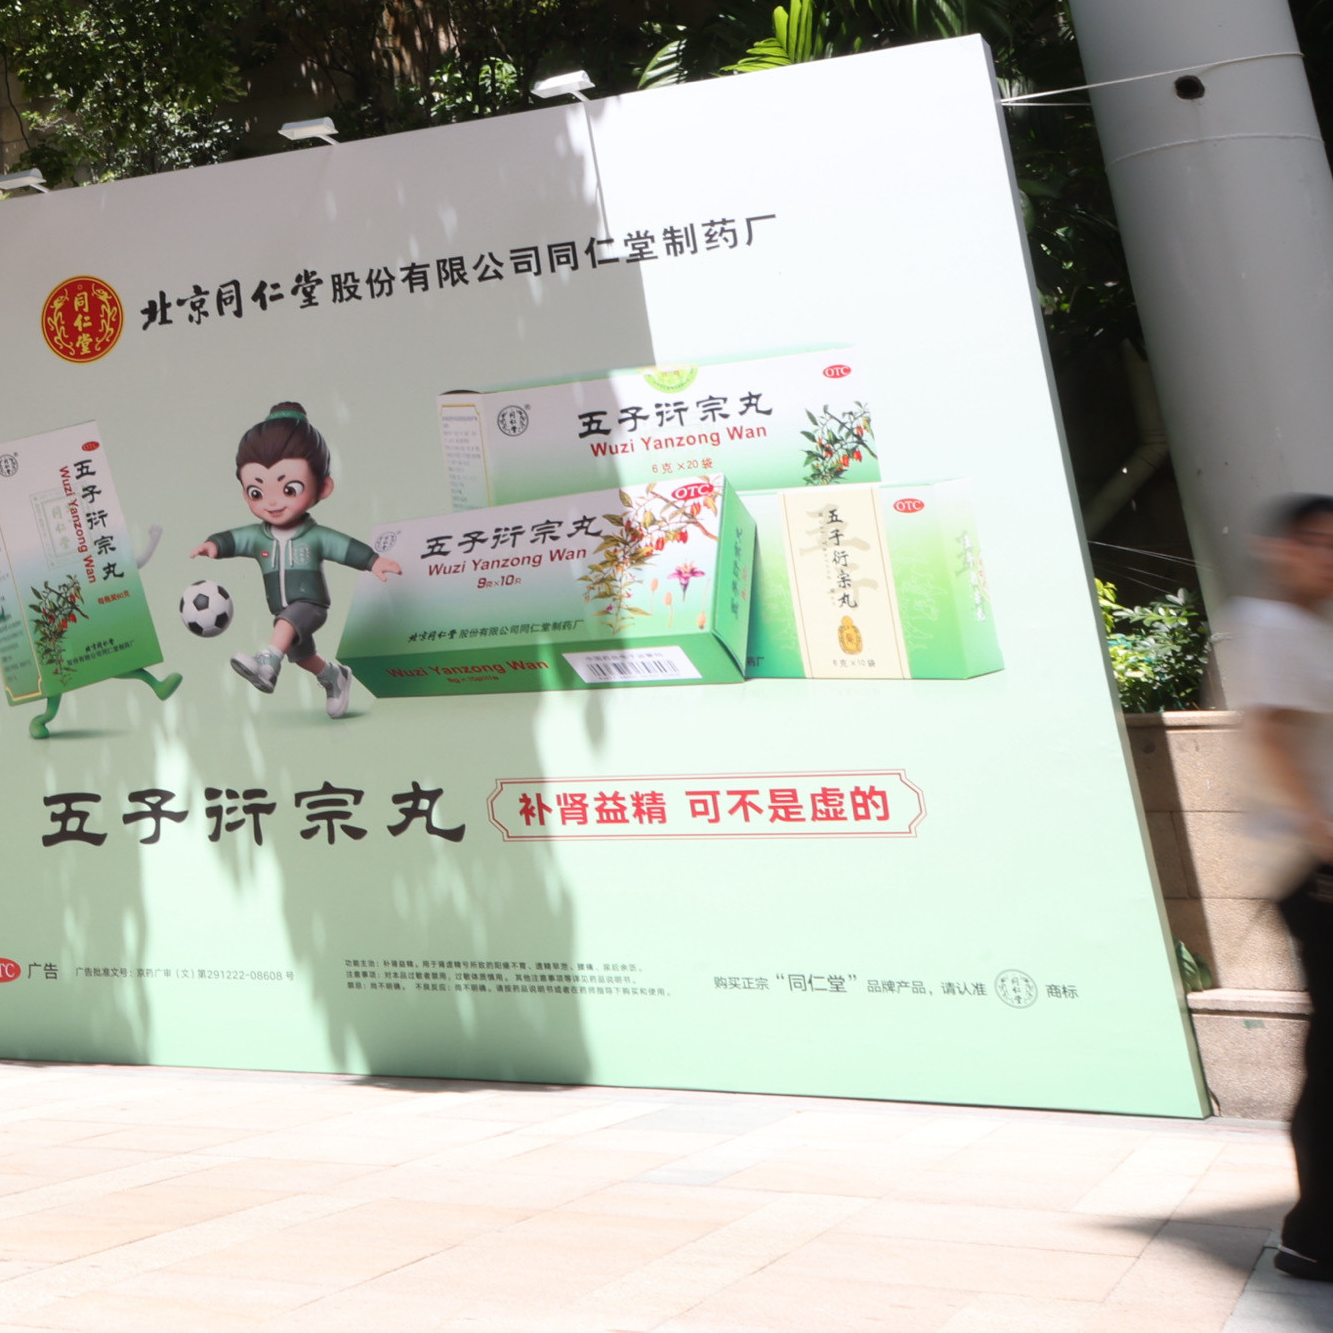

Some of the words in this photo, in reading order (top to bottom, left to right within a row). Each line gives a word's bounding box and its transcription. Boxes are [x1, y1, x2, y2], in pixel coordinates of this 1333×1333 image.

[140, 213, 776, 331] 北京同仁堂股份有限公司同仁堂制药厂
[72, 290, 94, 356] 同仁堂
[823, 365, 849, 378] OTC
[577, 390, 774, 440] 五子衍宗丸
[590, 438, 635, 457] Wuzi
[641, 429, 723, 452] Yanzong
[726, 423, 768, 441] Wan
[673, 483, 711, 499] OTC
[894, 500, 923, 512] OTC
[59, 466, 74, 498] Wuzi
[67, 499, 89, 554] Yanzong
[83, 555, 97, 584] Wan
[73, 459, 125, 582] 五子衍宗丸
[421, 515, 603, 560] 五子衍宗丸
[428, 559, 466, 577] Wuzi
[472, 551, 543, 574] Yanzong
[549, 547, 587, 563] Wan
[826, 508, 859, 610] 五子衍宗丸
[385, 667, 429, 678] Wuzi
[428, 662, 507, 676] Yanzong
[505, 659, 550, 671] Wan
[41, 778, 467, 848] 五子衍宗丸
[517, 789, 668, 827] 补肾益精
[684, 783, 891, 826] 可不是虚的
[27, 962, 59, 981] 广告
[1046, 983, 1079, 1000] 商标
